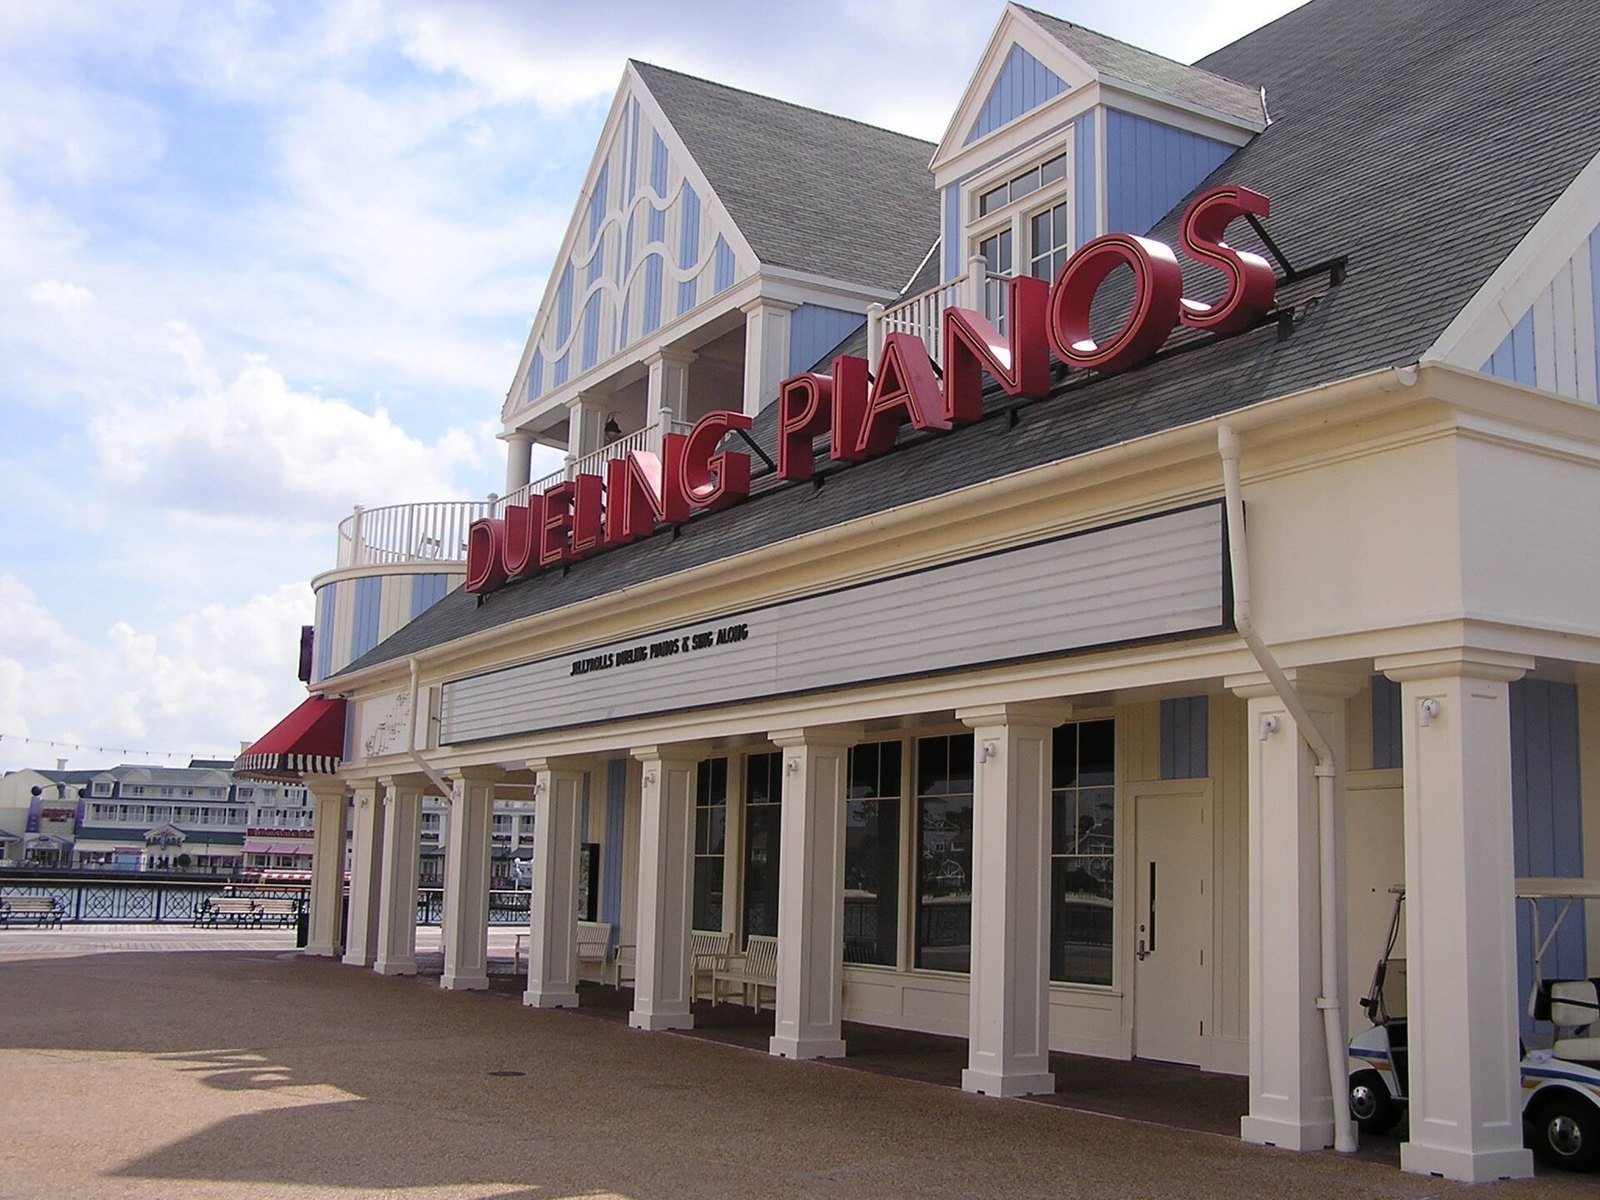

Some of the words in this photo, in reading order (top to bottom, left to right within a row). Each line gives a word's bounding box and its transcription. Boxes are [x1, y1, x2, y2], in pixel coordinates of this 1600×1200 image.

[465, 409, 752, 594] DUELING
[777, 184, 1277, 481] PIANOS
[616, 646, 648, 667] DUELING
[650, 638, 680, 659] PIANOS
[691, 631, 714, 650] SING
[716, 623, 749, 645] ALONG
